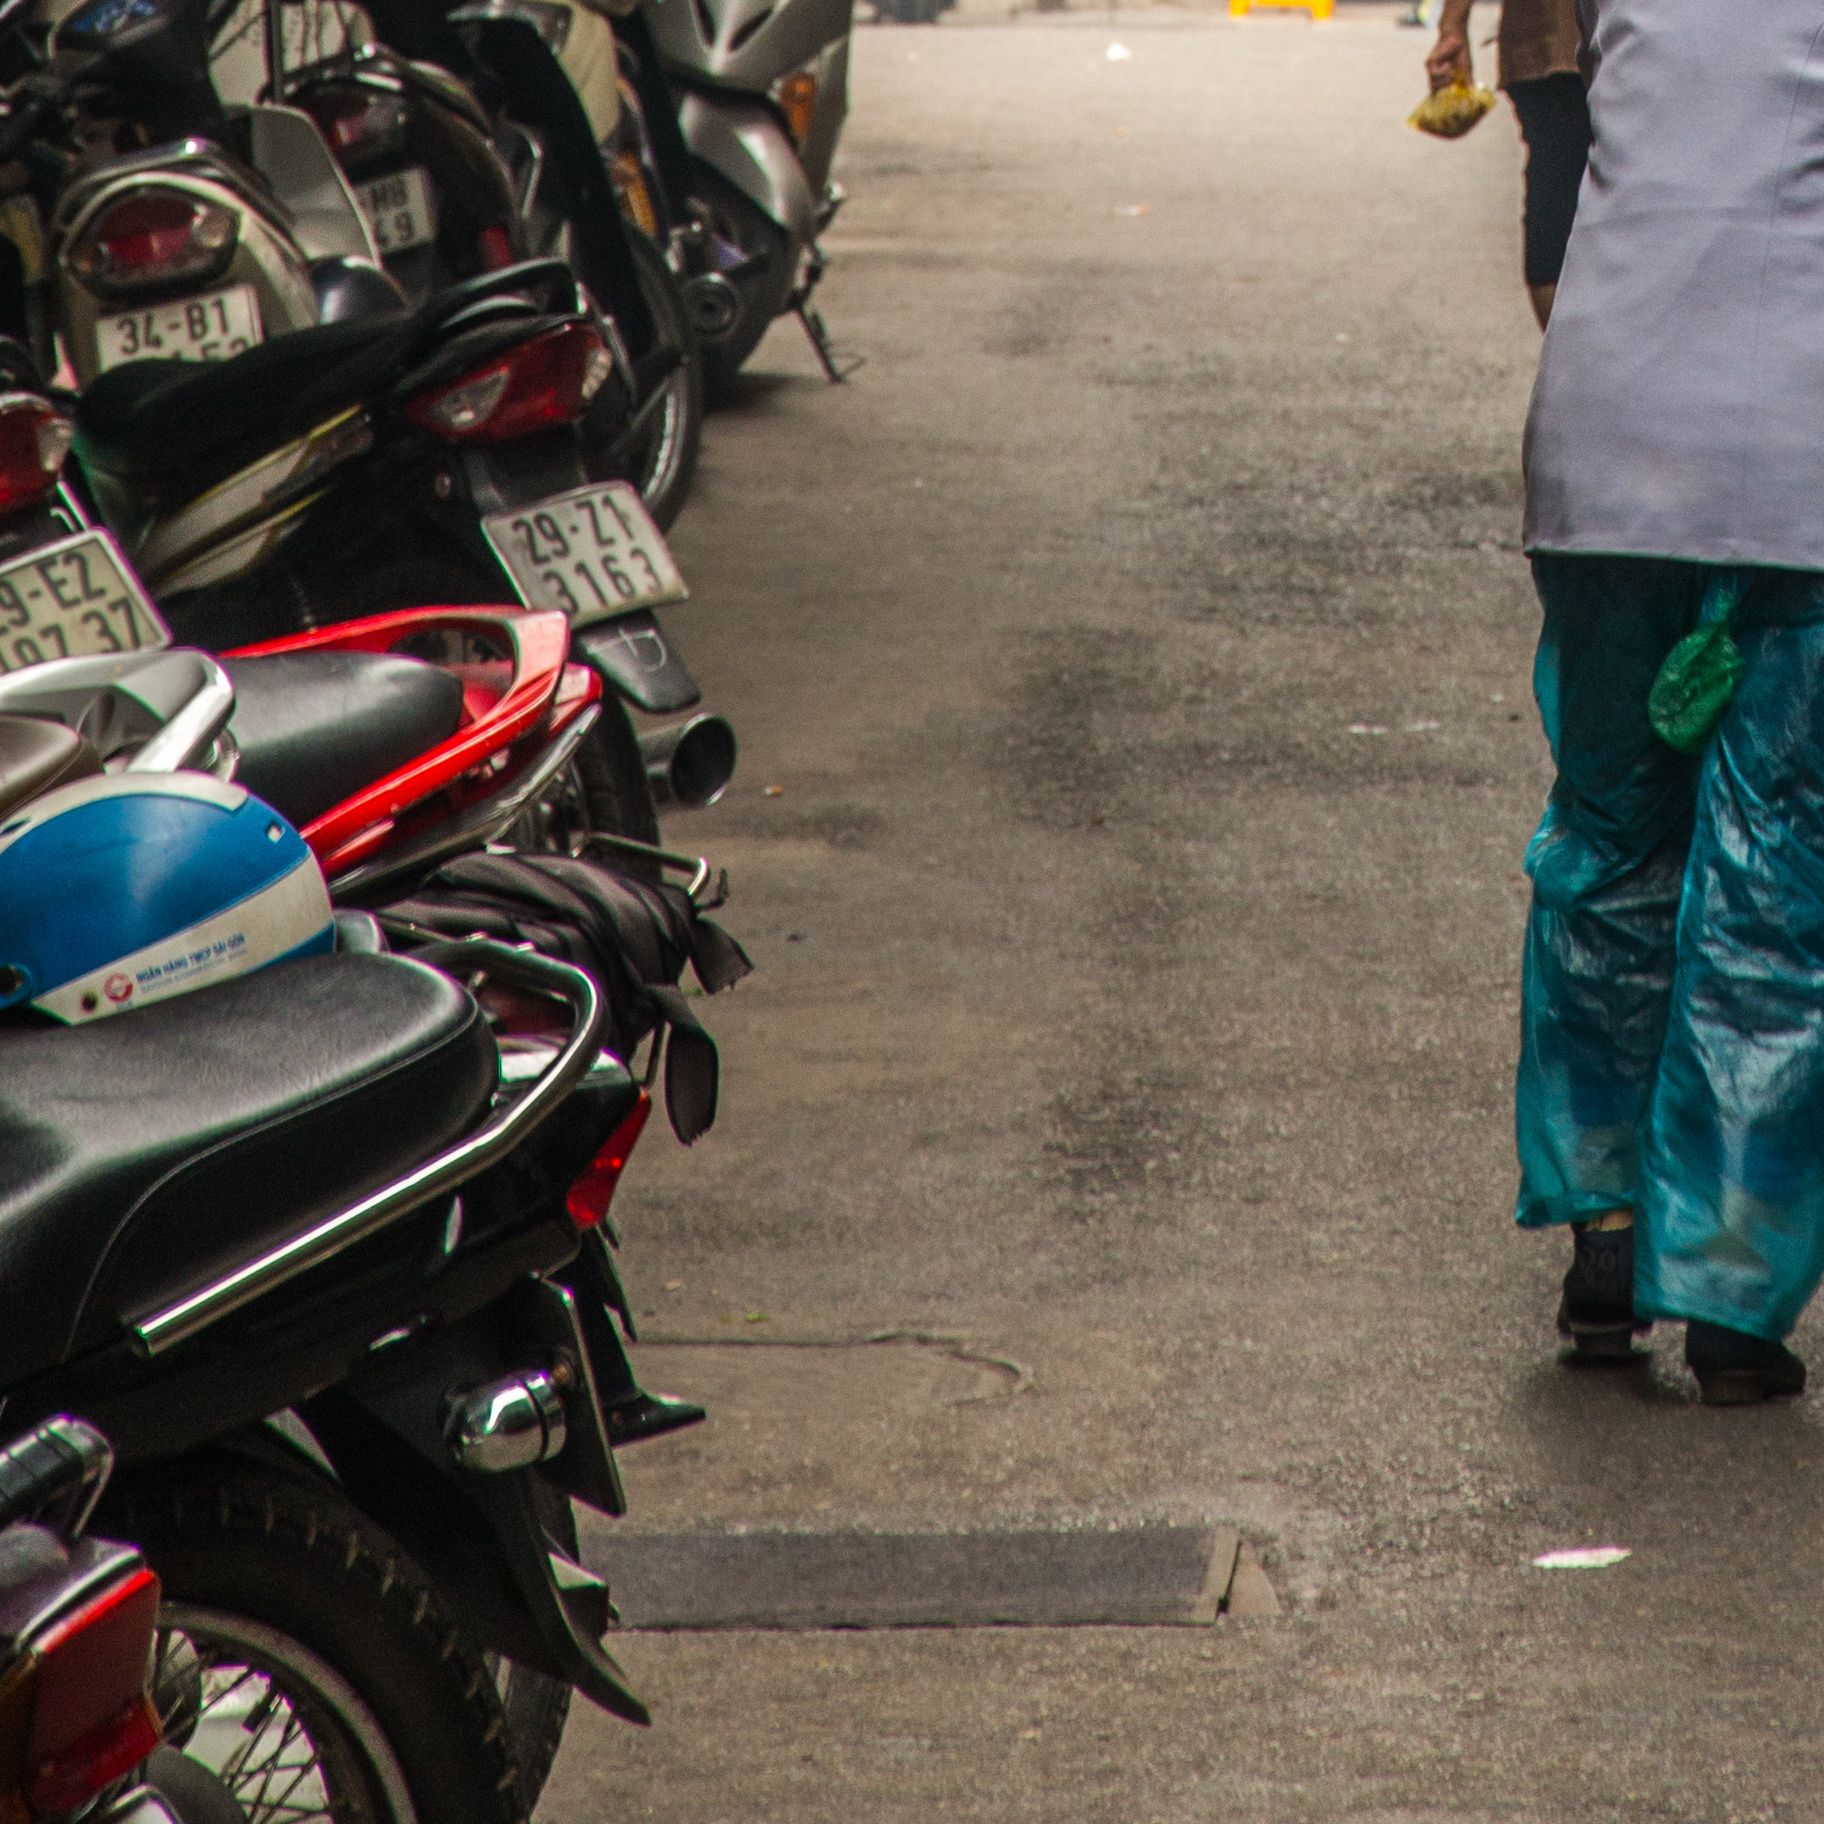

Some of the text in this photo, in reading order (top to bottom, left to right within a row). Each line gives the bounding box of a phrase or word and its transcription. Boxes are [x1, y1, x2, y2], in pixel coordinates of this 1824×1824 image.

[117, 298, 229, 357] 34-B1
[511, 495, 634, 566] 29-Z1
[0, 550, 106, 636] 9-E2
[544, 548, 662, 616] 3163
